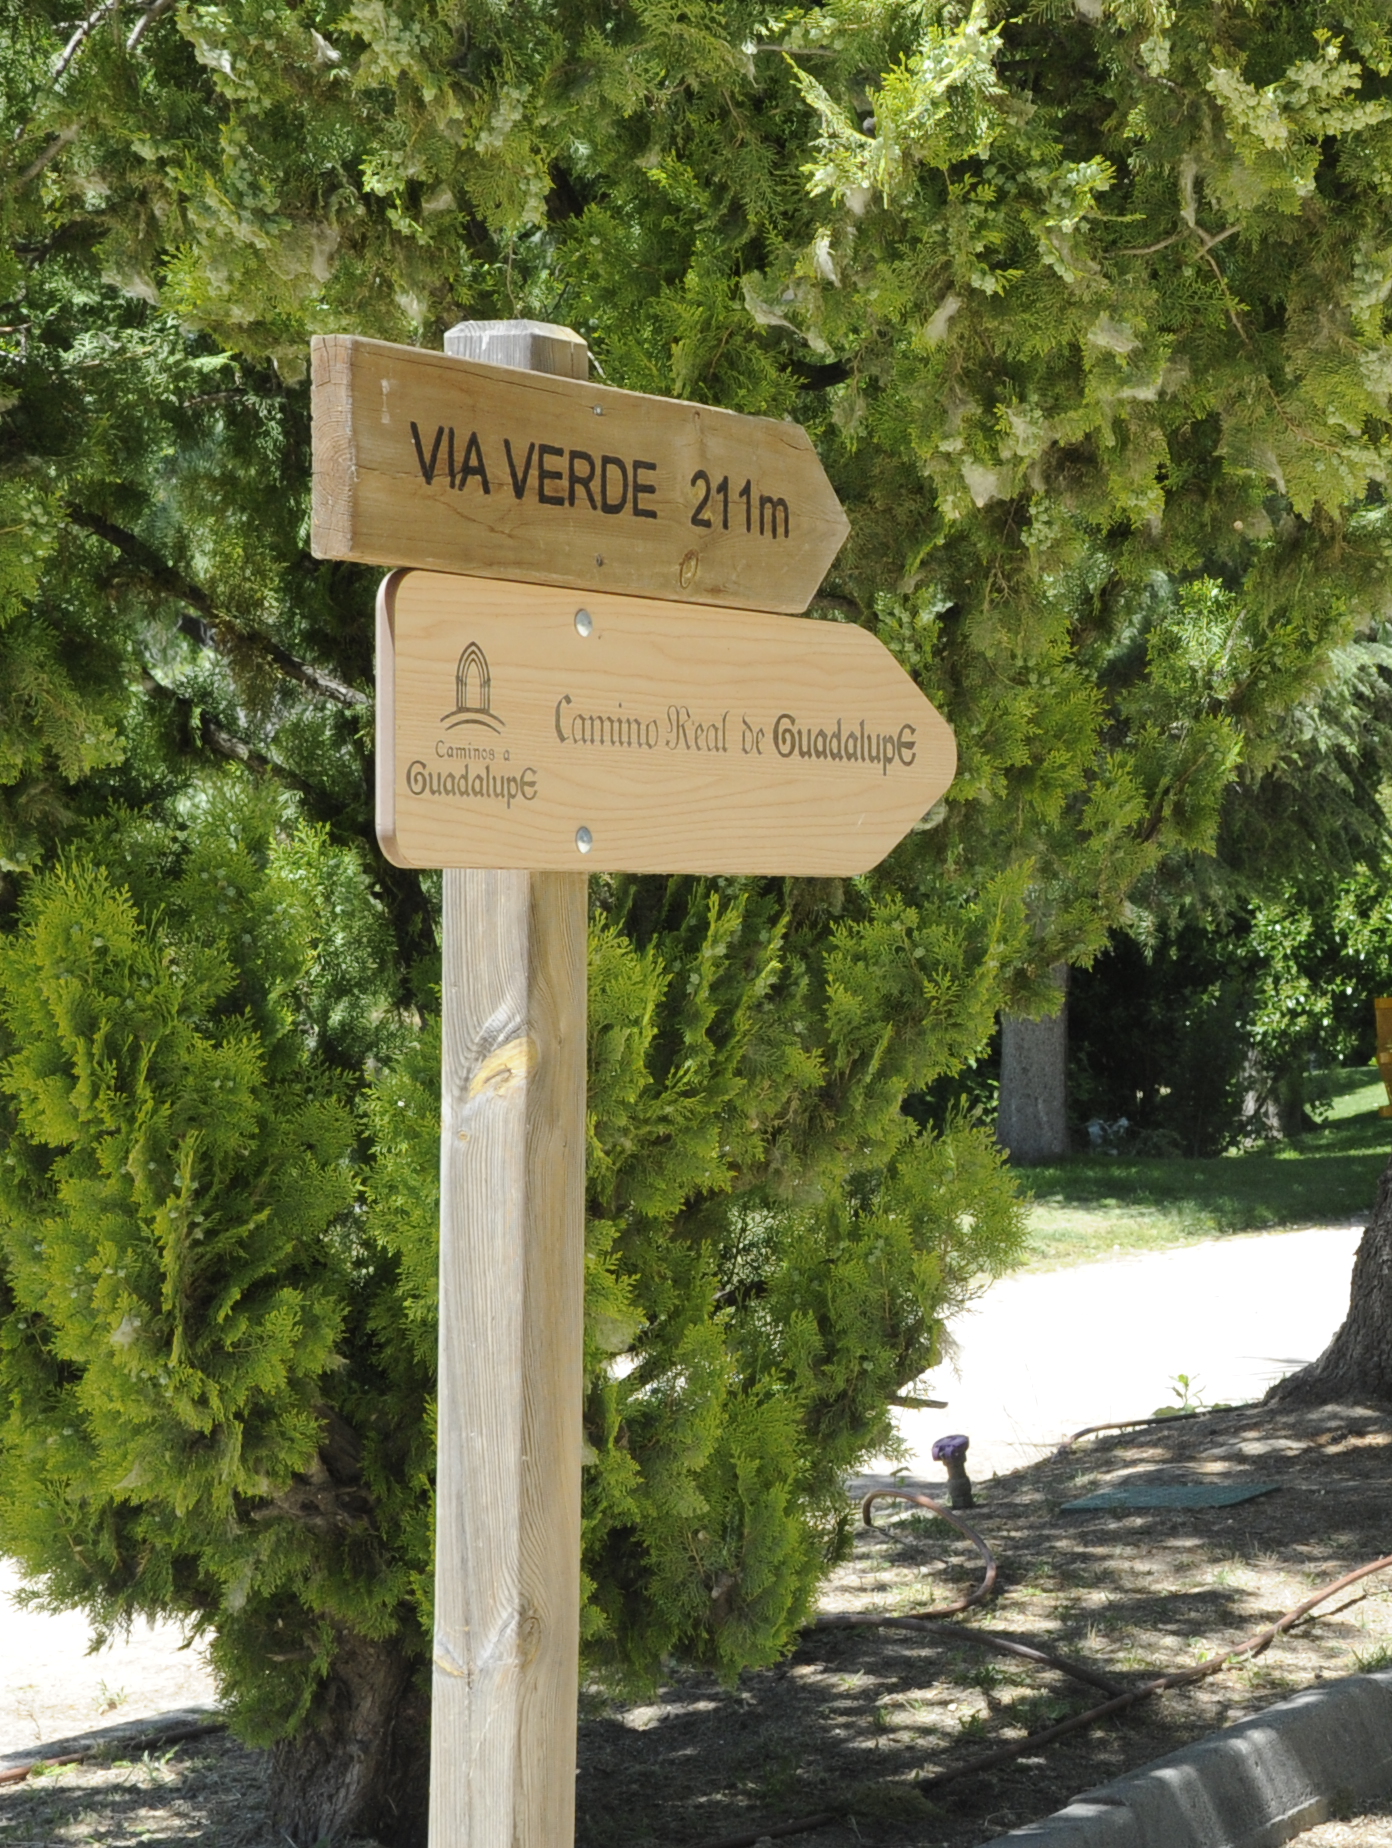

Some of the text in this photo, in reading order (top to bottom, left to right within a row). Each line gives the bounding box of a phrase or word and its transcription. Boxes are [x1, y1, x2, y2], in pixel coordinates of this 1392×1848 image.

[409, 420, 791, 539] VIA VERDE 211m
[434, 739, 511, 762] Caminos a
[554, 693, 659, 751] Camino
[664, 704, 730, 755] Real
[740, 711, 765, 757] de
